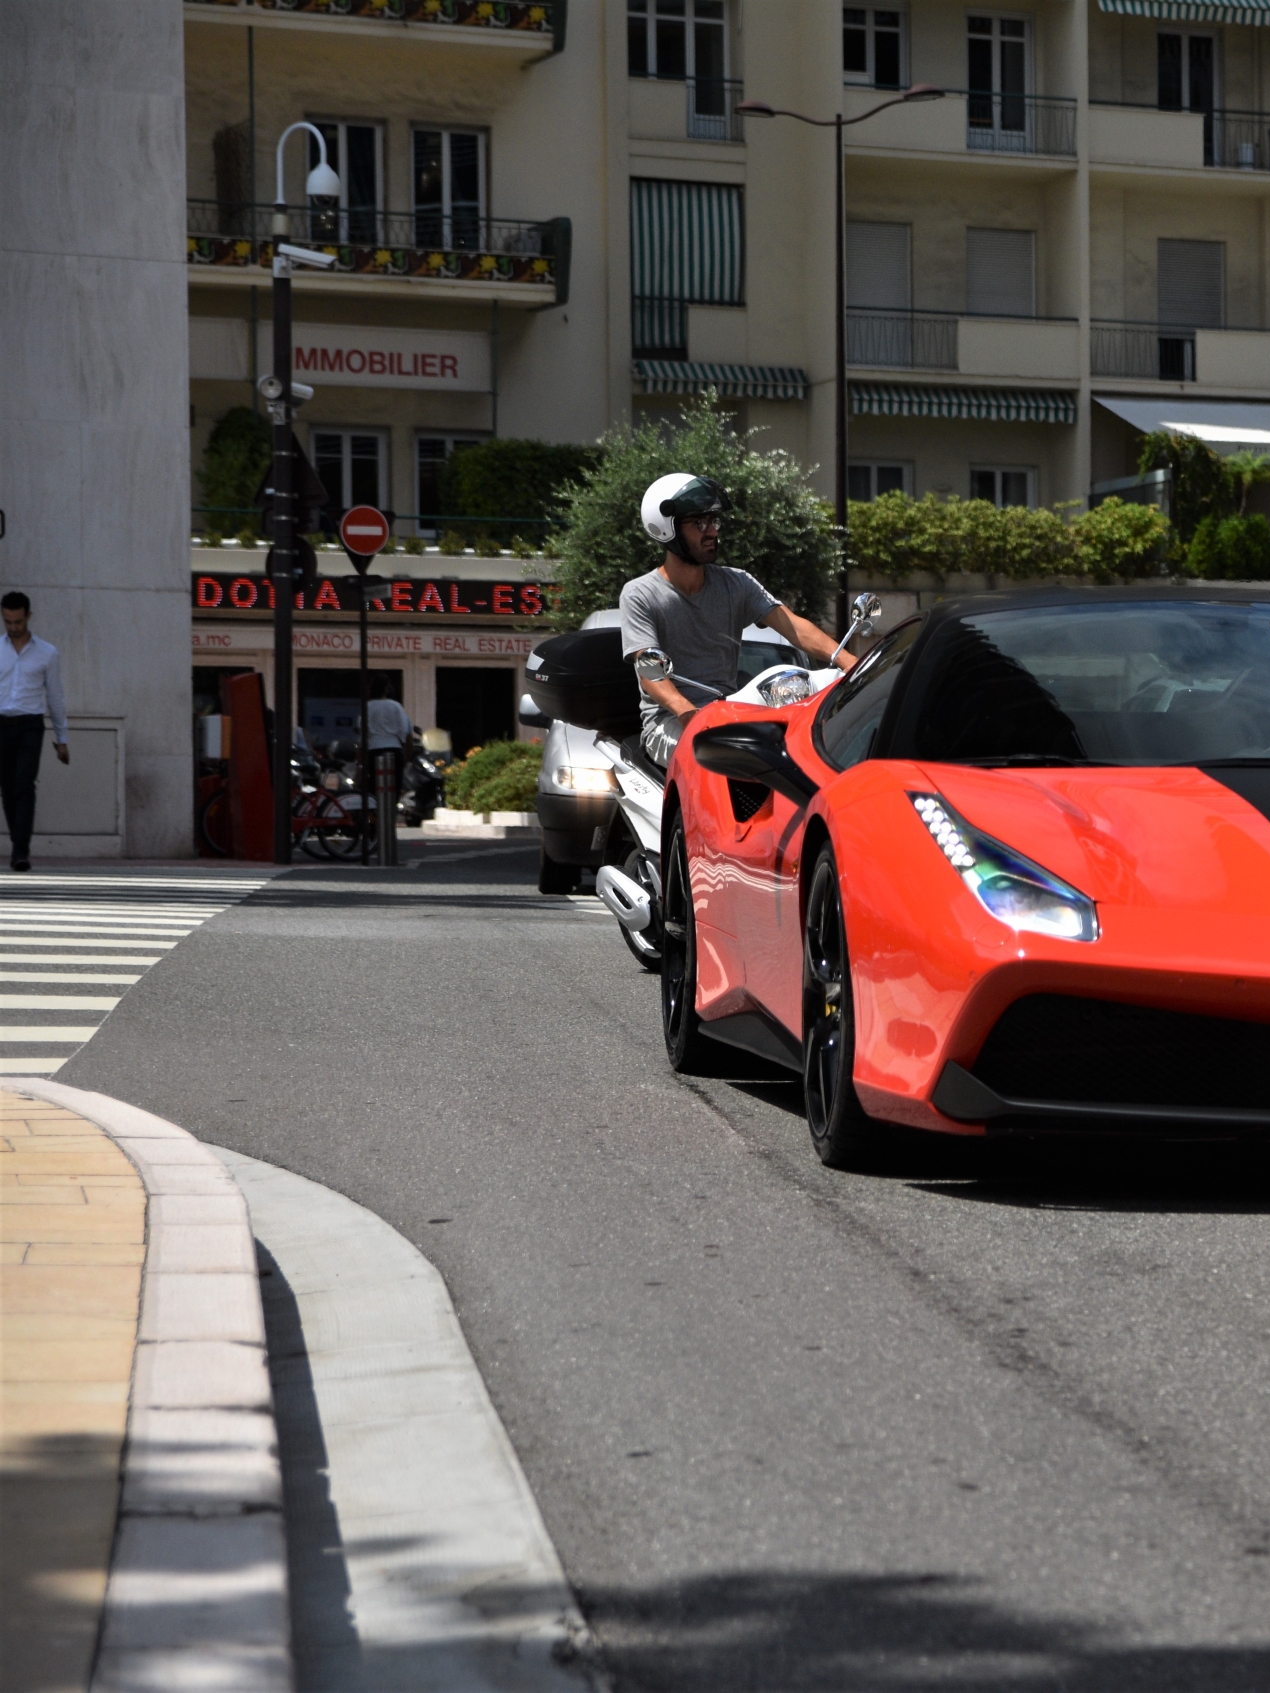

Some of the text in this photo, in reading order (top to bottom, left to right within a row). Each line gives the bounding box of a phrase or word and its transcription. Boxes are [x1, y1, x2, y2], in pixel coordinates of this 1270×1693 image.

[295, 346, 459, 379] MMOBILIER
[292, 634, 533, 653] MONACO PRIVATE REAL ESTATE
